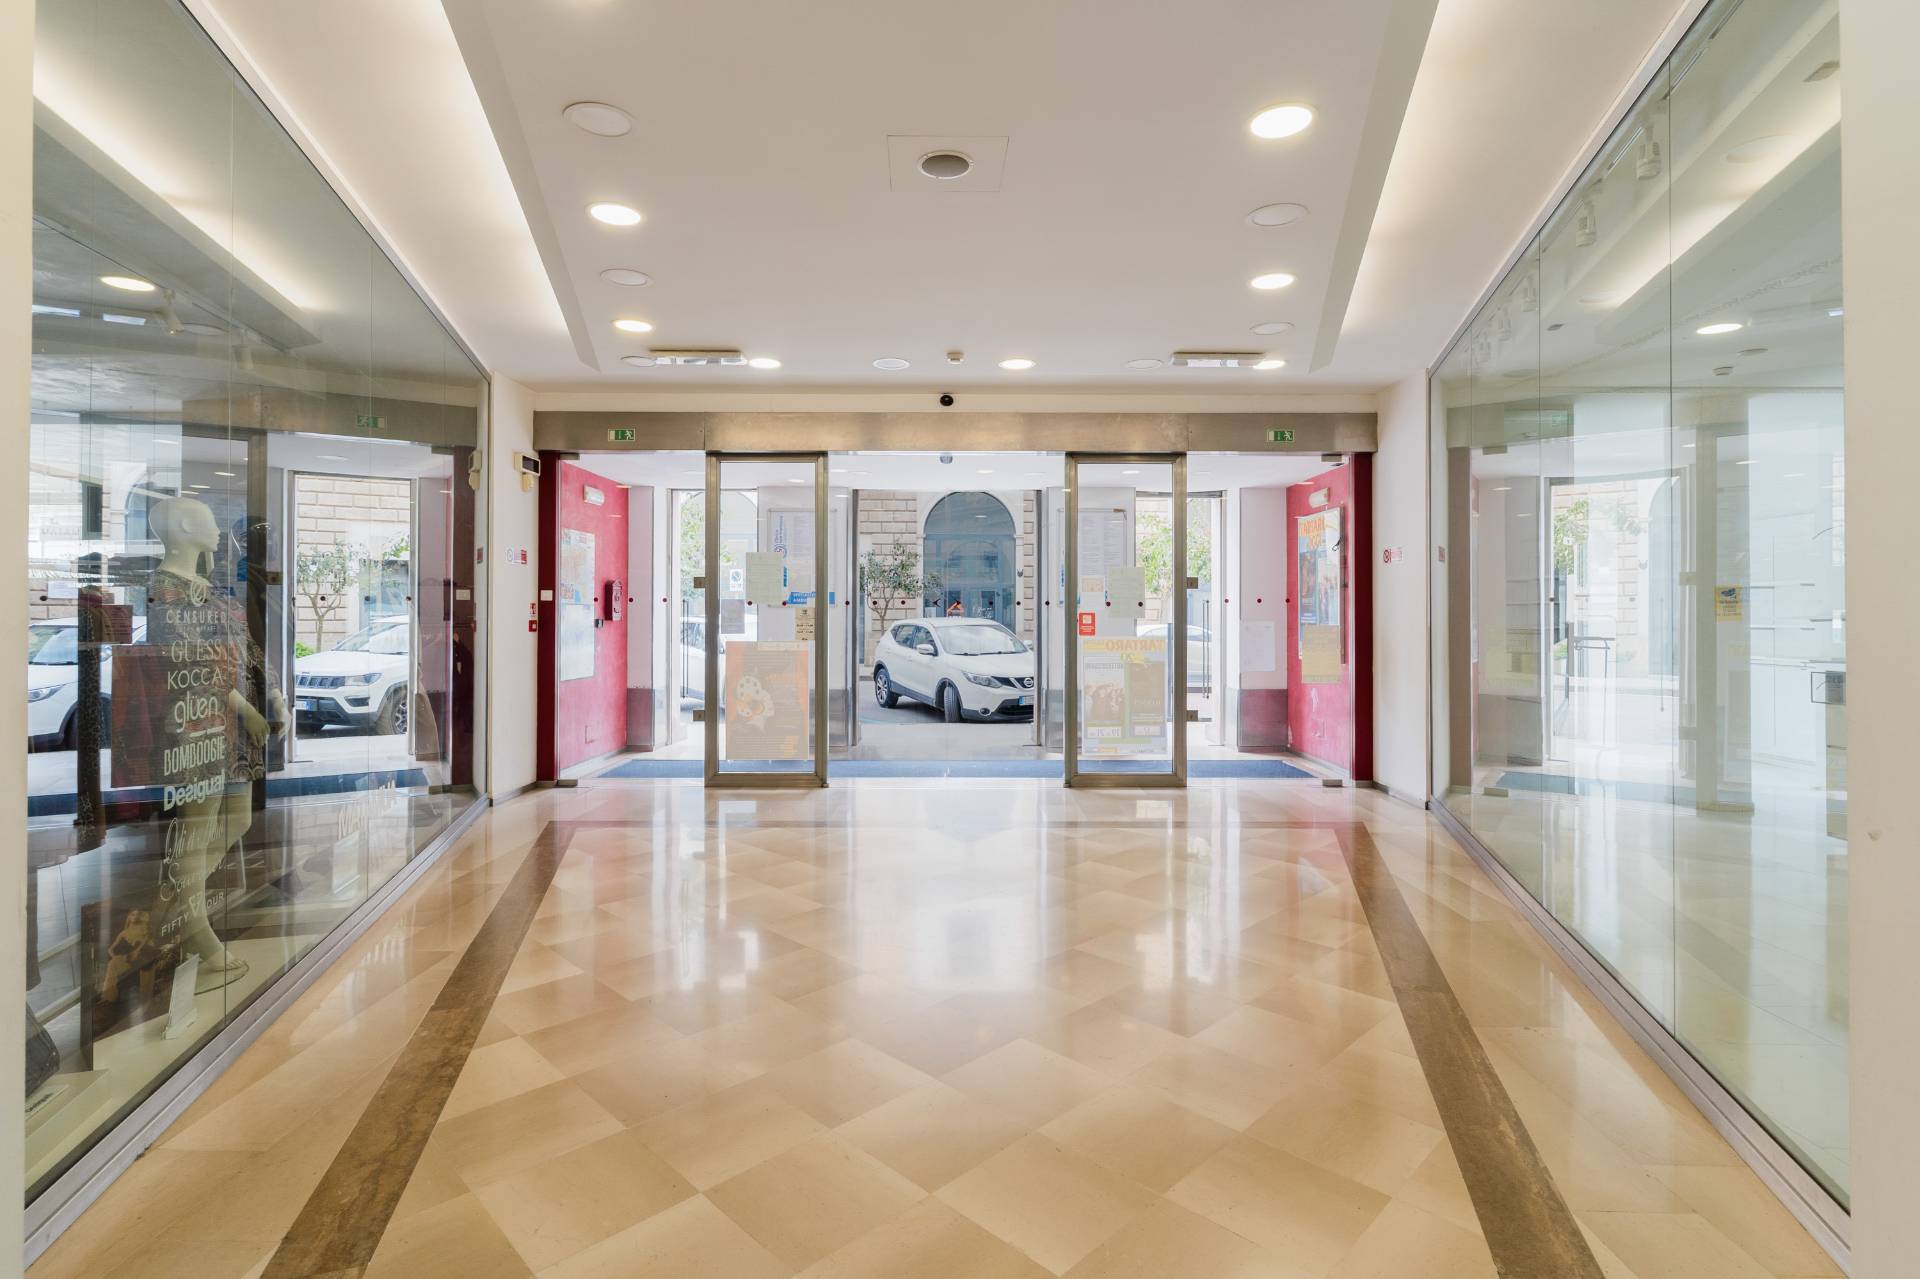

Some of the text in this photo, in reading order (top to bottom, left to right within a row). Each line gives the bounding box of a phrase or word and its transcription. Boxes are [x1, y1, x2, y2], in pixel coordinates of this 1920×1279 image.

[166, 609, 227, 624] CENSURED
[171, 639, 227, 663] GUESS
[167, 666, 224, 690] KOCCA
[174, 690, 218, 733] glüen
[164, 736, 226, 776] BOMBOOGIE
[164, 769, 226, 811] Desigual
[161, 912, 190, 937] FIFTY
